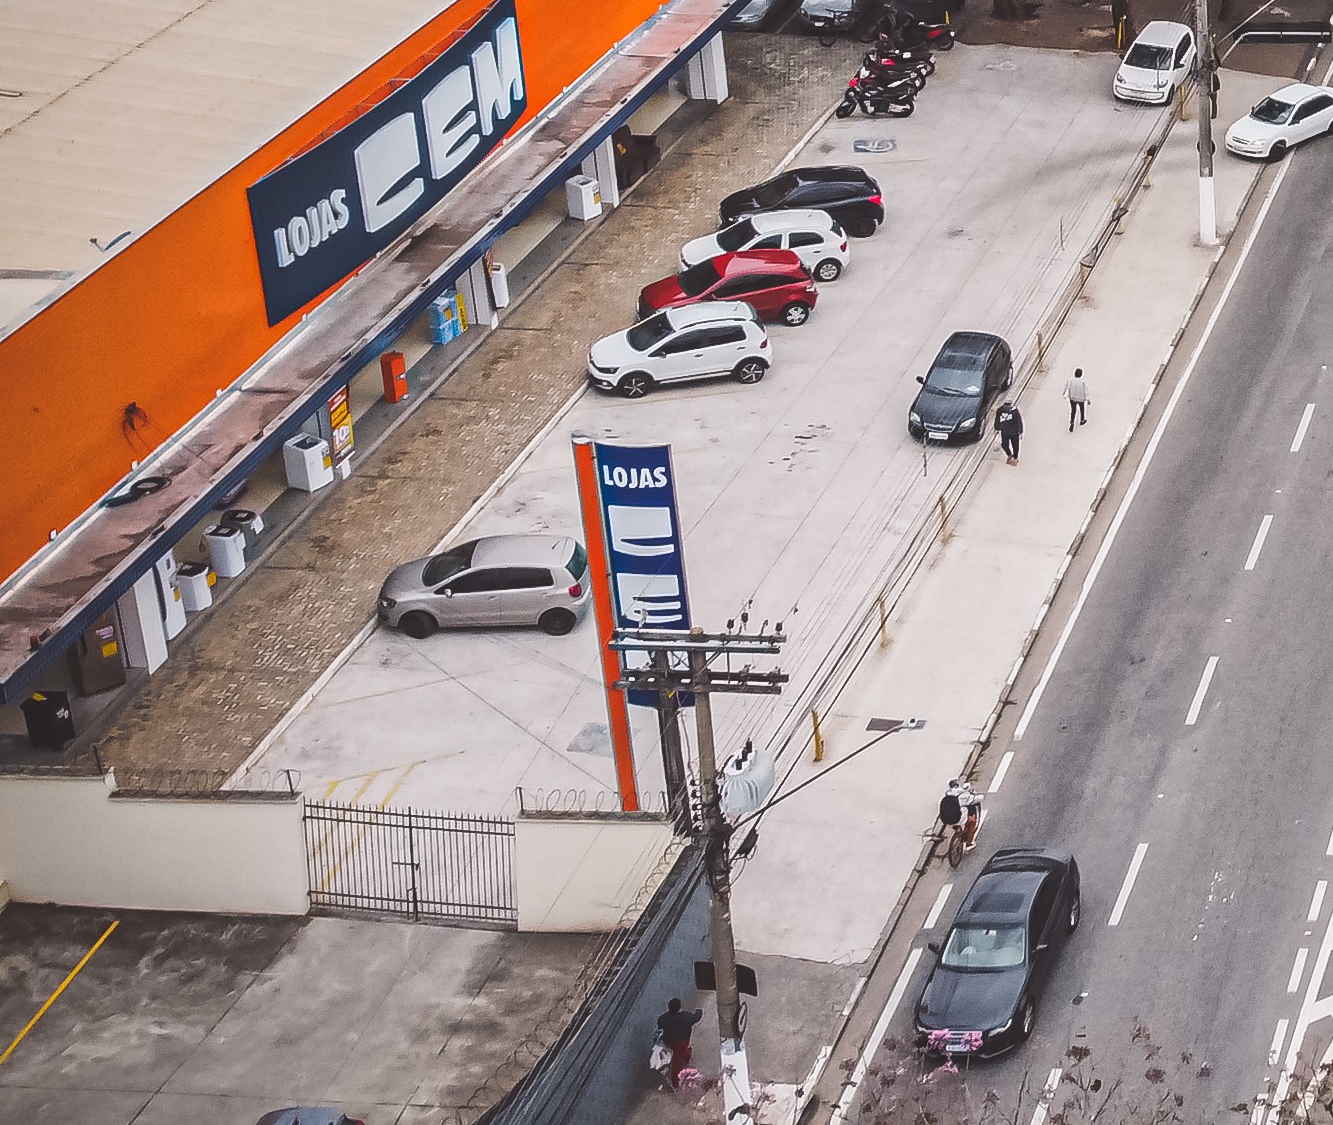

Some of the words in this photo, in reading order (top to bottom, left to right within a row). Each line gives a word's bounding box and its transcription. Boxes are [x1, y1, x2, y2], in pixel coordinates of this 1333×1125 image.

[274, 188, 350, 267] LOJAS
[354, 17, 523, 232] CEM
[603, 464, 668, 488] LOJAS
